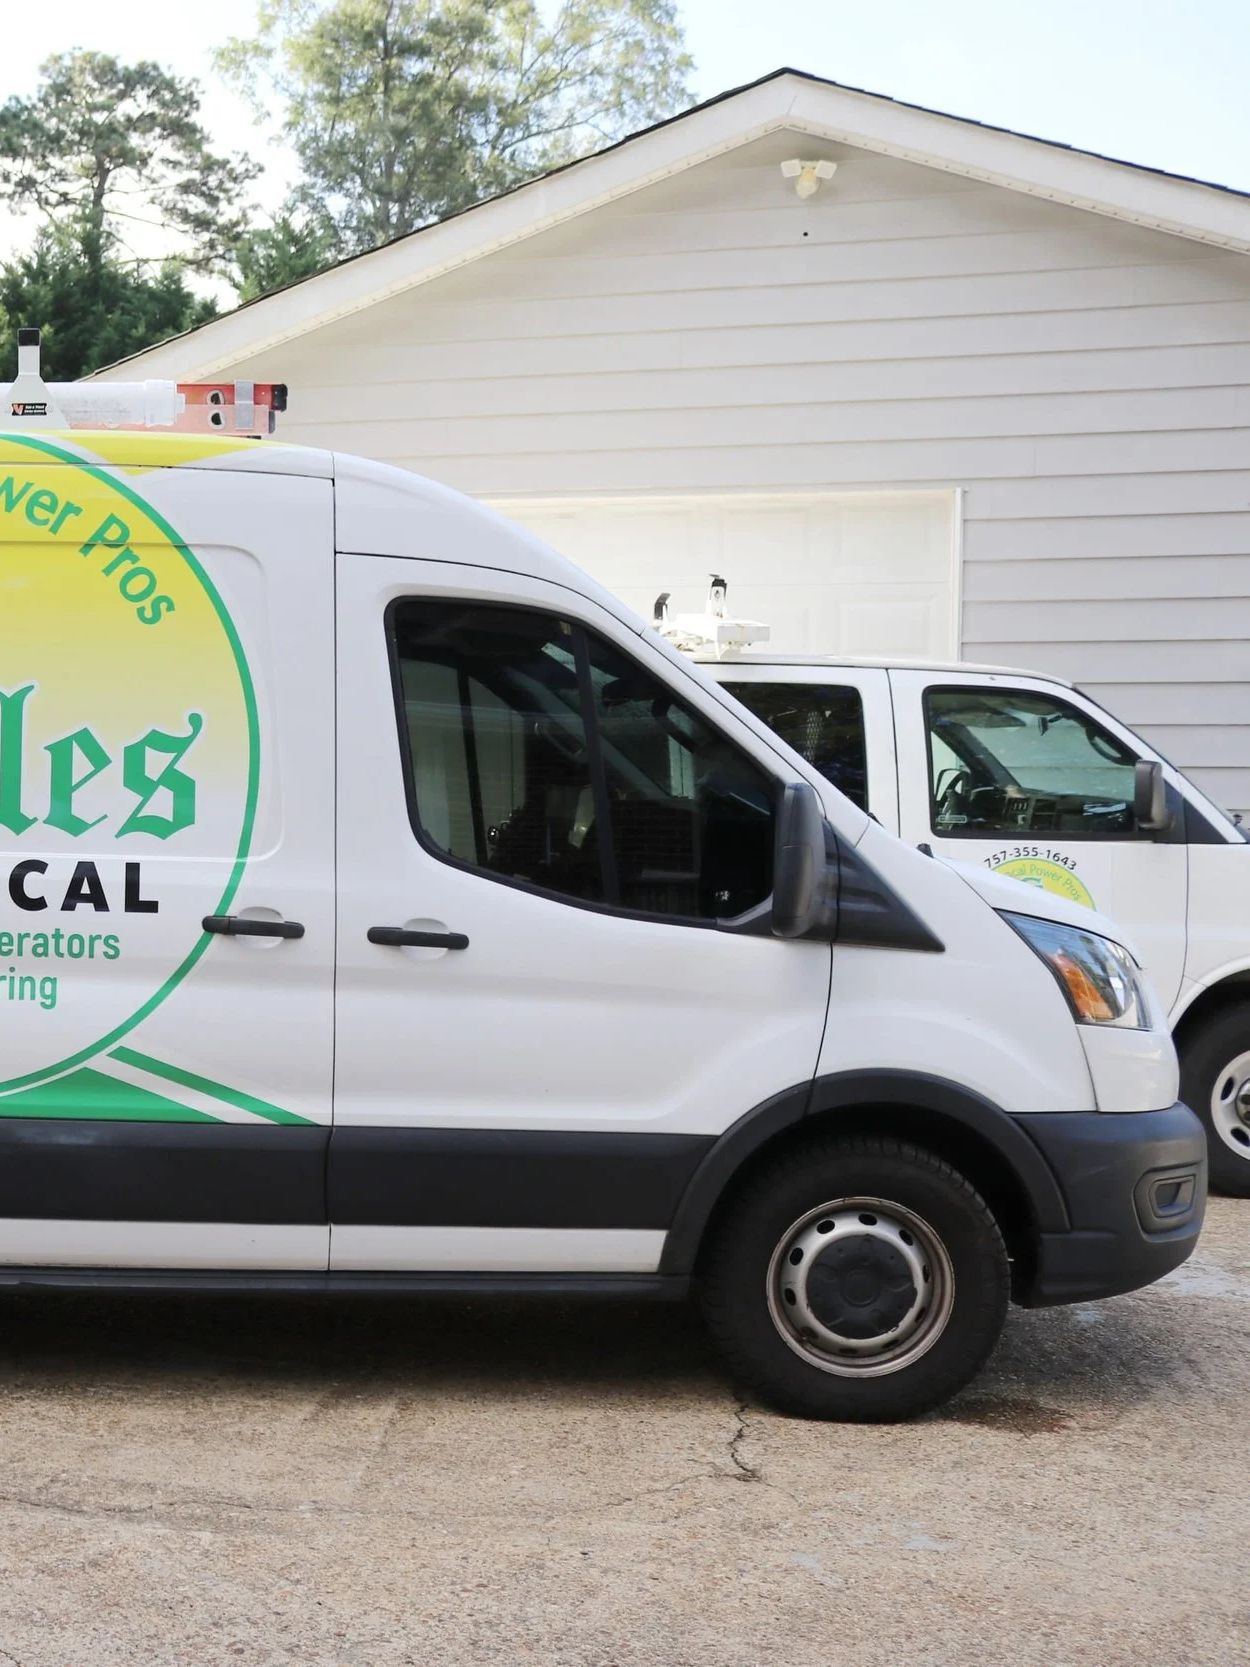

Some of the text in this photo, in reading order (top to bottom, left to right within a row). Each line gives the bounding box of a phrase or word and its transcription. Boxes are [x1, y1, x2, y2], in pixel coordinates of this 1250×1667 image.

[78, 512, 175, 625] Pros
[983, 847, 1077, 870] 757-355-1643
[1030, 864, 1062, 881] Power
